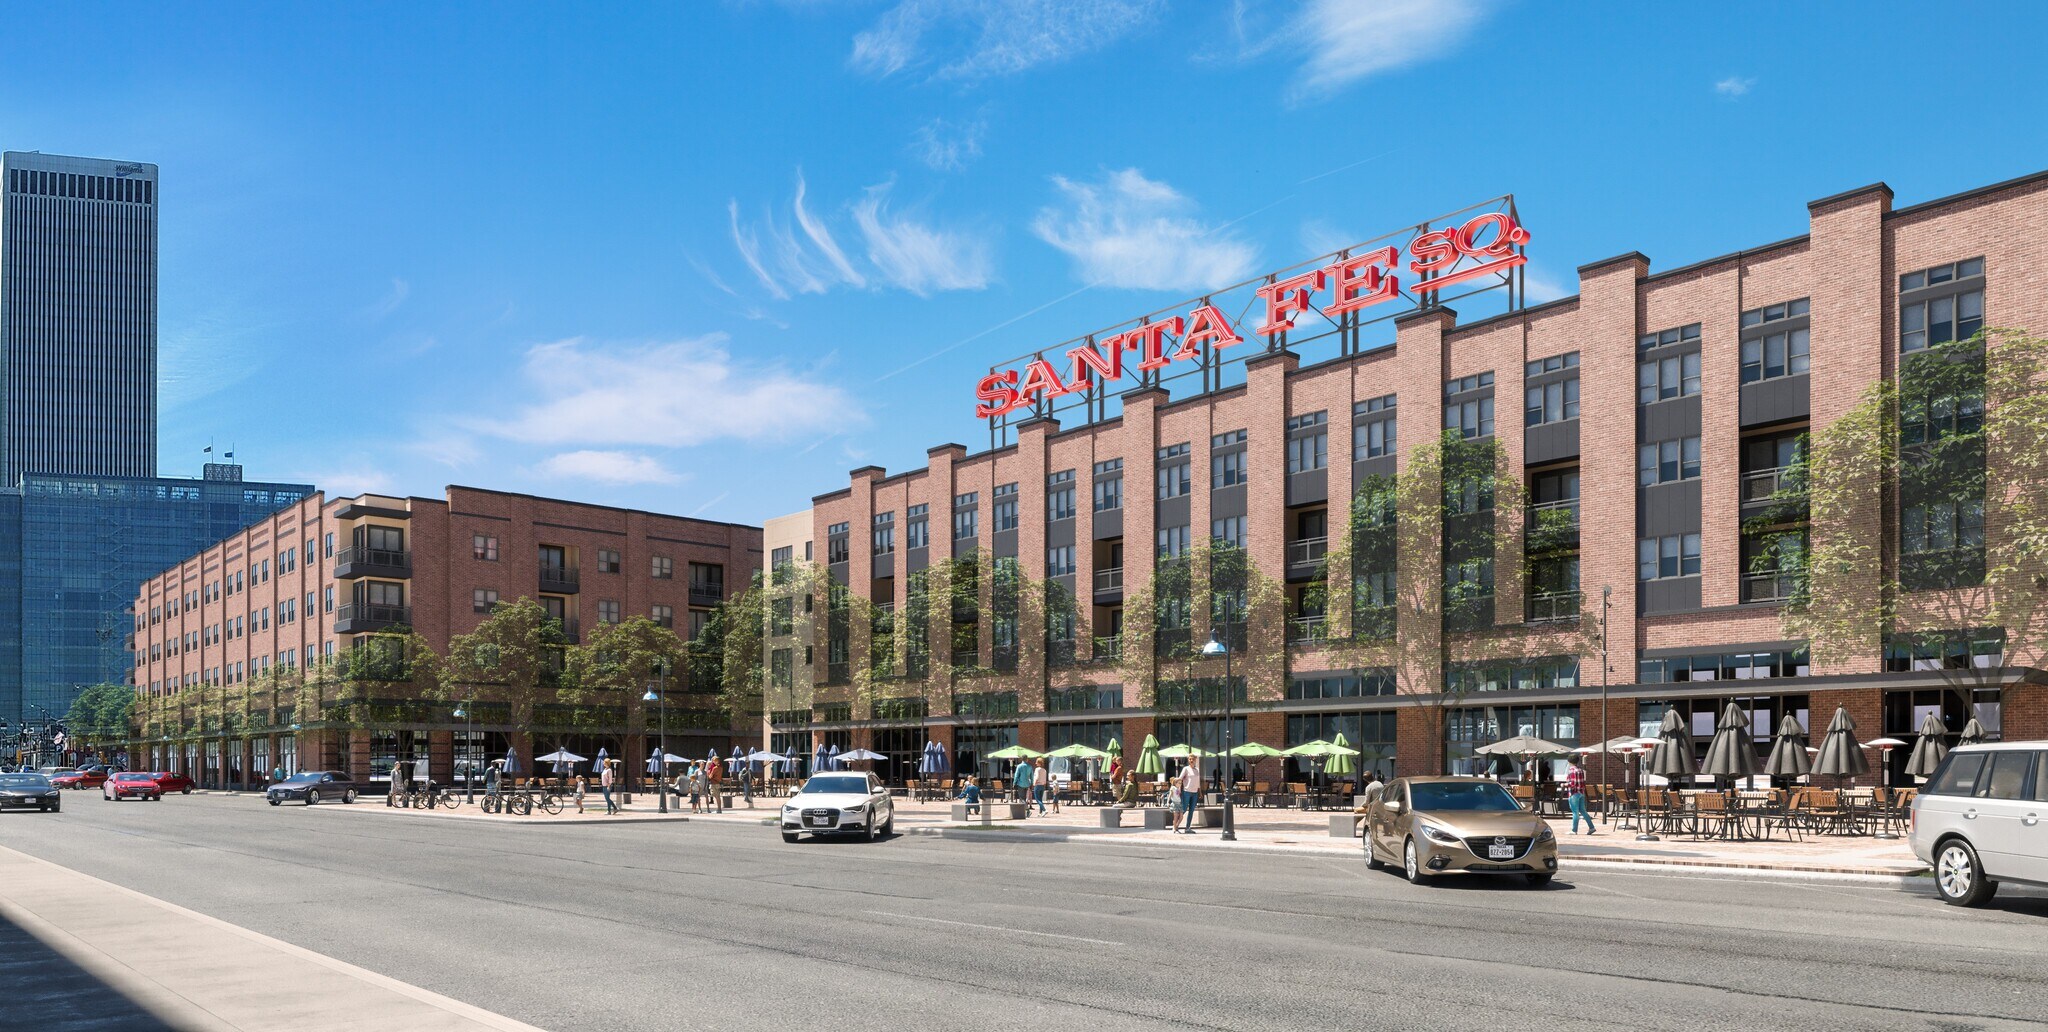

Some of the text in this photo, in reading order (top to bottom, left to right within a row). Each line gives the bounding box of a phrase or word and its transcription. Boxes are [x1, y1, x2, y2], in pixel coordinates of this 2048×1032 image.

[115, 164, 144, 174] Williams
[976, 213, 1531, 419] SANTA FE SQ.
